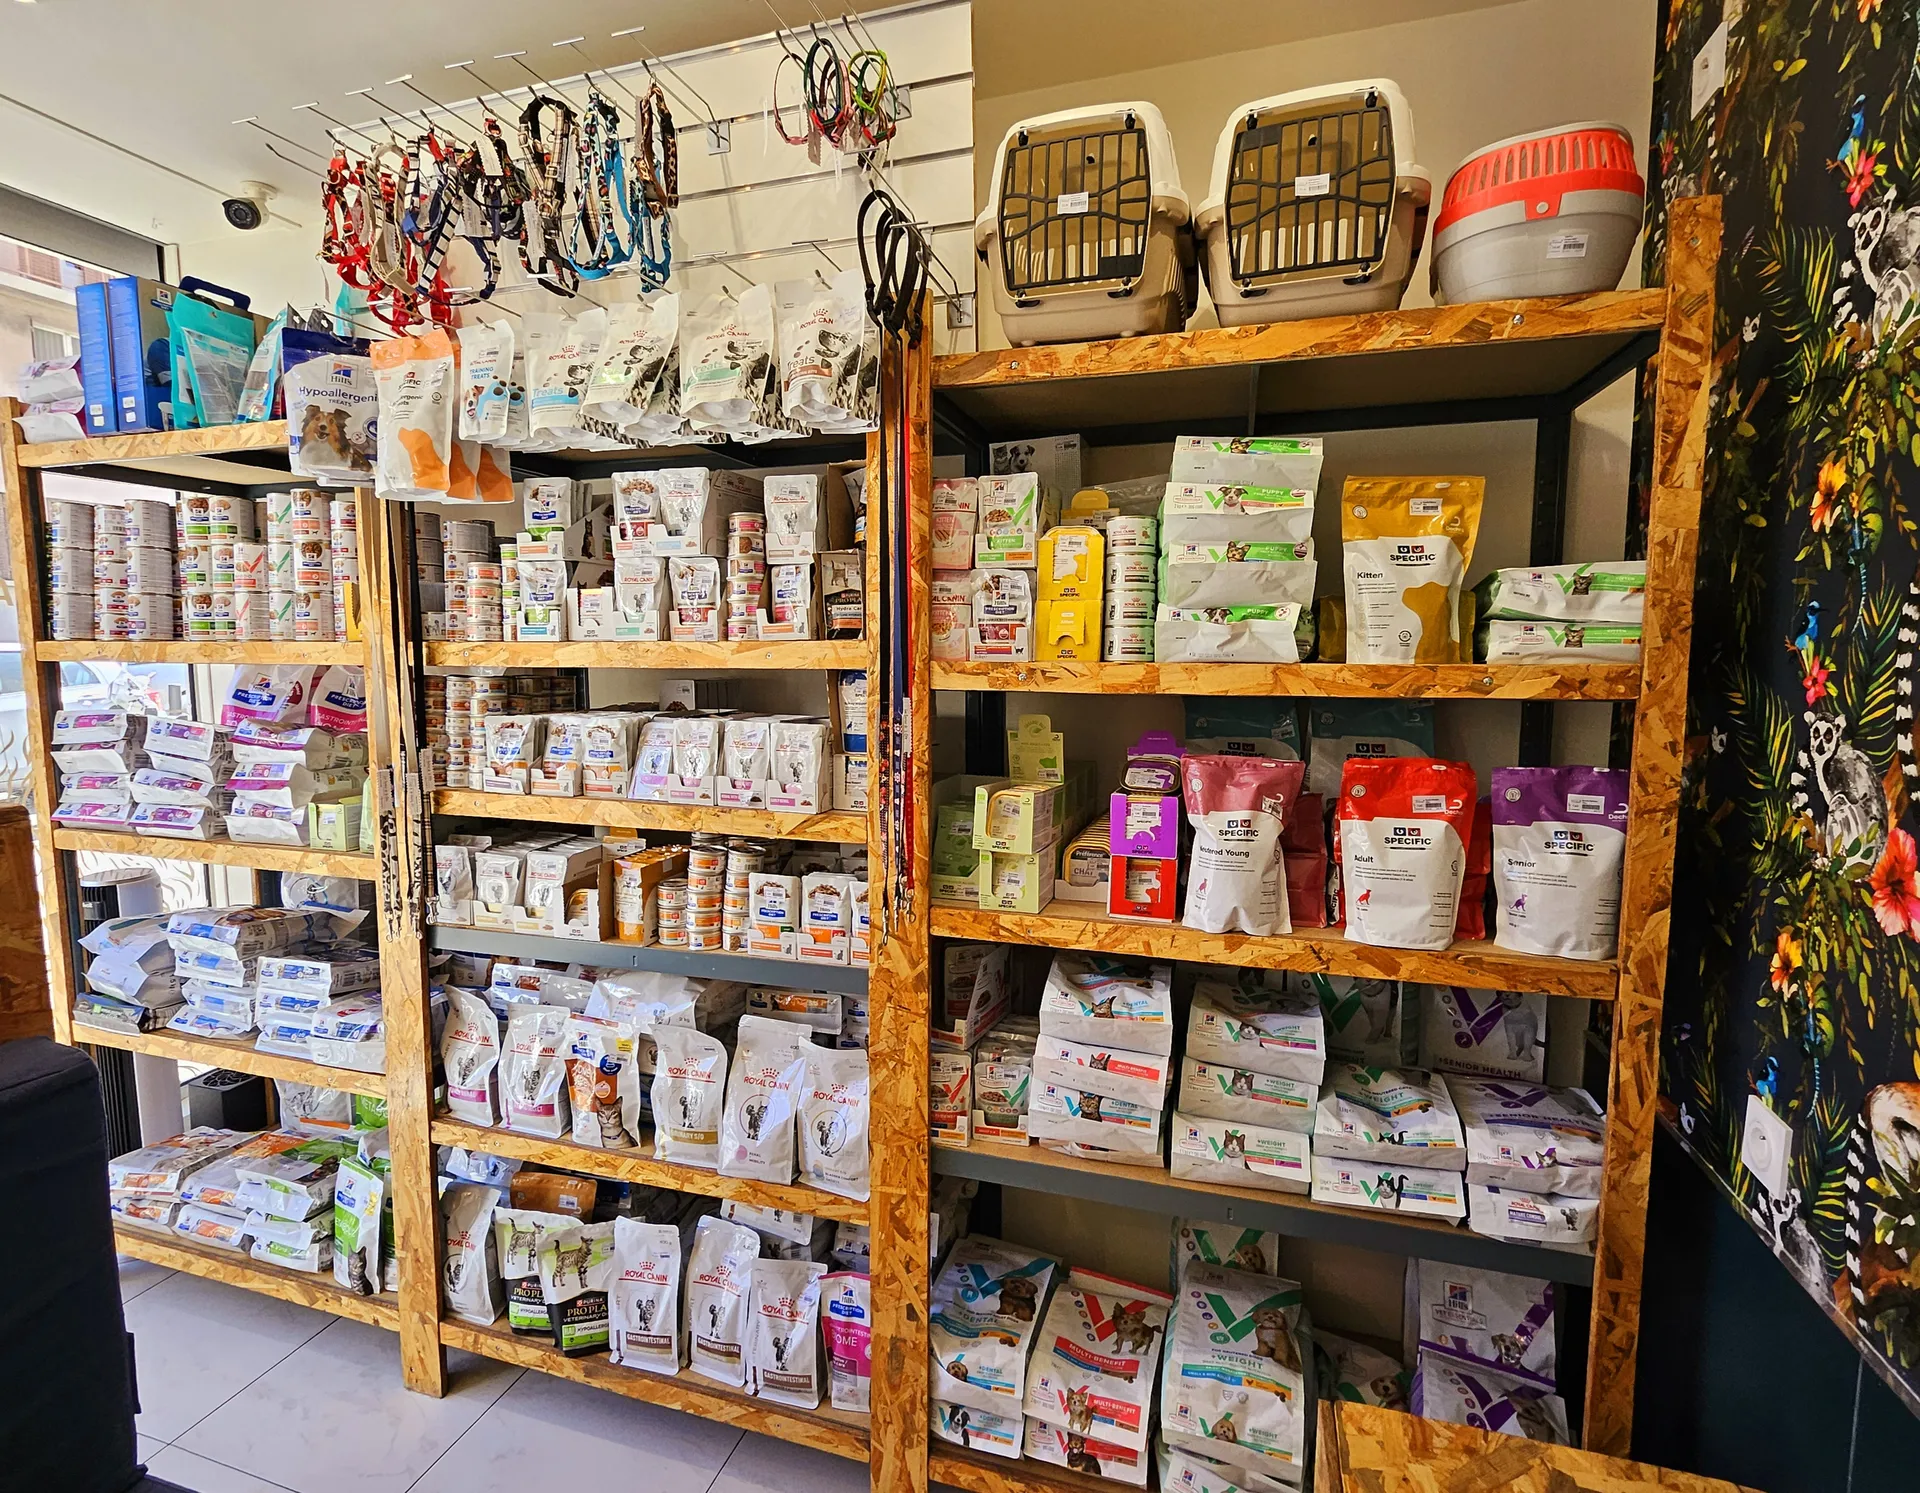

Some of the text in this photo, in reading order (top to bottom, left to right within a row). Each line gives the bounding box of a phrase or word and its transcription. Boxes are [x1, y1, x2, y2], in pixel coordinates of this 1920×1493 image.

[818, 317, 834, 325] CAN
[469, 366, 494, 375] TRAINING
[299, 386, 378, 404] Hypoallergeni
[533, 386, 564, 397] Treats
[328, 399, 352, 408] TREATS
[1389, 554, 1436, 562] SPECIFIC
[1356, 571, 1384, 580] Kitten
[941, 595, 966, 603] CANIN
[1218, 829, 1260, 837] SPECIFIC
[1384, 837, 1432, 845] SPECIFIC
[1544, 841, 1594, 851] SPECIFIC
[1225, 849, 1250, 858] Young
[1354, 855, 1374, 863] Adult
[1507, 858, 1536, 868] Senior
[1331, 888, 1340, 909] CIFIC
[455, 1030, 491, 1043] ROYAL CNIN
[667, 1066, 713, 1080] ROYAL CANIN
[1438, 1057, 1522, 1079] +SENIOR HEALTH
[743, 1075, 790, 1091] ROYAL CANIN
[1266, 1079, 1295, 1088] +WEIGHT
[813, 1090, 860, 1107] ROYAL CANIN
[1543, 1115, 1592, 1128] HEALTH
[1257, 1139, 1286, 1147] +WEIGHT
[1526, 1213, 1543, 1221] CONSUL
[447, 1239, 461, 1247] OYAL
[625, 1269, 668, 1282] ROYAL CANIN
[700, 1273, 721, 1284] ROYAL
[513, 1287, 544, 1297] PRO PL
[511, 1296, 540, 1305] VETERINARY
[582, 1298, 604, 1306] PURINA
[567, 1305, 608, 1316] PRO PLA
[762, 1304, 784, 1317] ROYAL
[832, 1303, 863, 1315] PRESCRIPTION
[563, 1313, 600, 1322] VETERINARY
[577, 1323, 609, 1332] HYPOALLERG
[626, 1331, 671, 1345] GASTROINTESTINAL
[834, 1333, 858, 1347] OME
[697, 1338, 740, 1354] GASTROINTESTINAL
[1068, 1343, 1127, 1367] MULTI-BENEFIT
[1211, 1353, 1264, 1370] +WEIGHT
[978, 1365, 1003, 1374] +DENTAL
[763, 1372, 811, 1384] GASTROINTESTINAL
[1093, 1399, 1136, 1415] MULTI-BENEFIT
[1248, 1428, 1278, 1439] +WEIGHT
